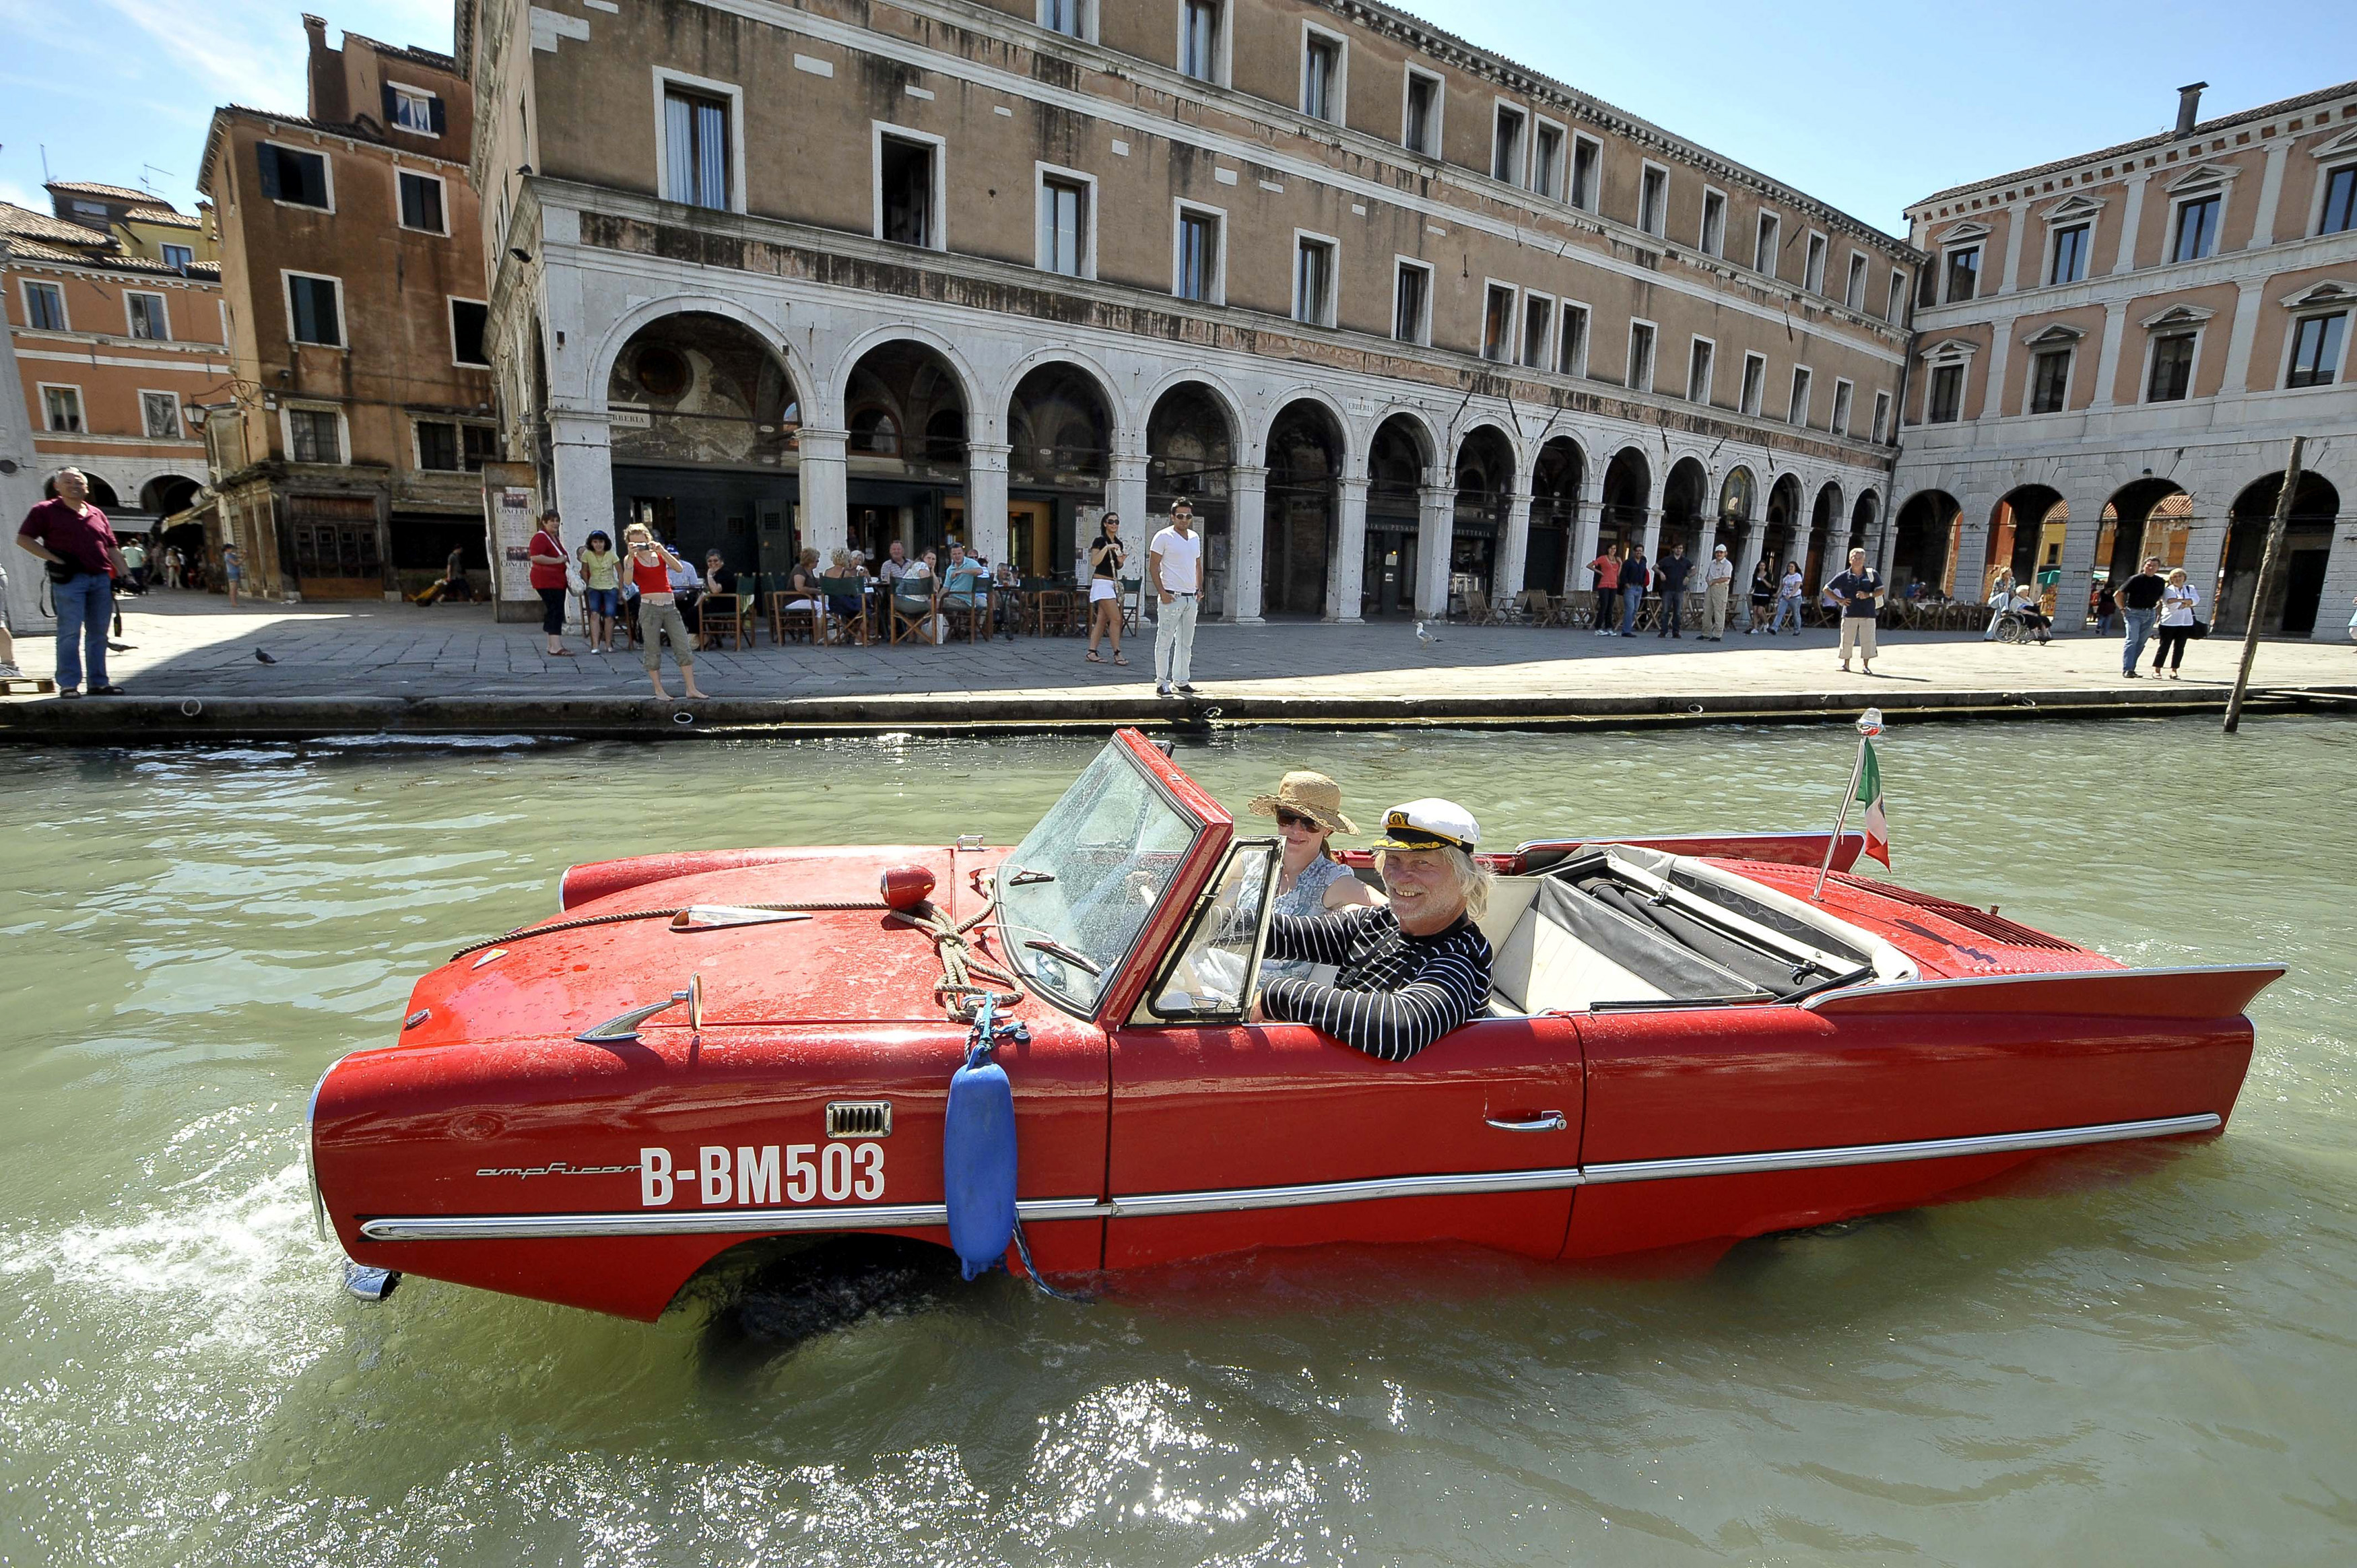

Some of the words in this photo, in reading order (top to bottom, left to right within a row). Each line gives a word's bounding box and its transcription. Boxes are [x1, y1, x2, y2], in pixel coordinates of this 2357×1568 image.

[612, 414, 644, 423] RBERIA
[496, 506, 534, 516] CONCERTO
[1391, 524, 1419, 532] PESADO
[1453, 529, 1490, 537] CHETTERIA
[500, 559, 531, 568] CONCERT
[640, 1142, 885, 1206] B-BM503
